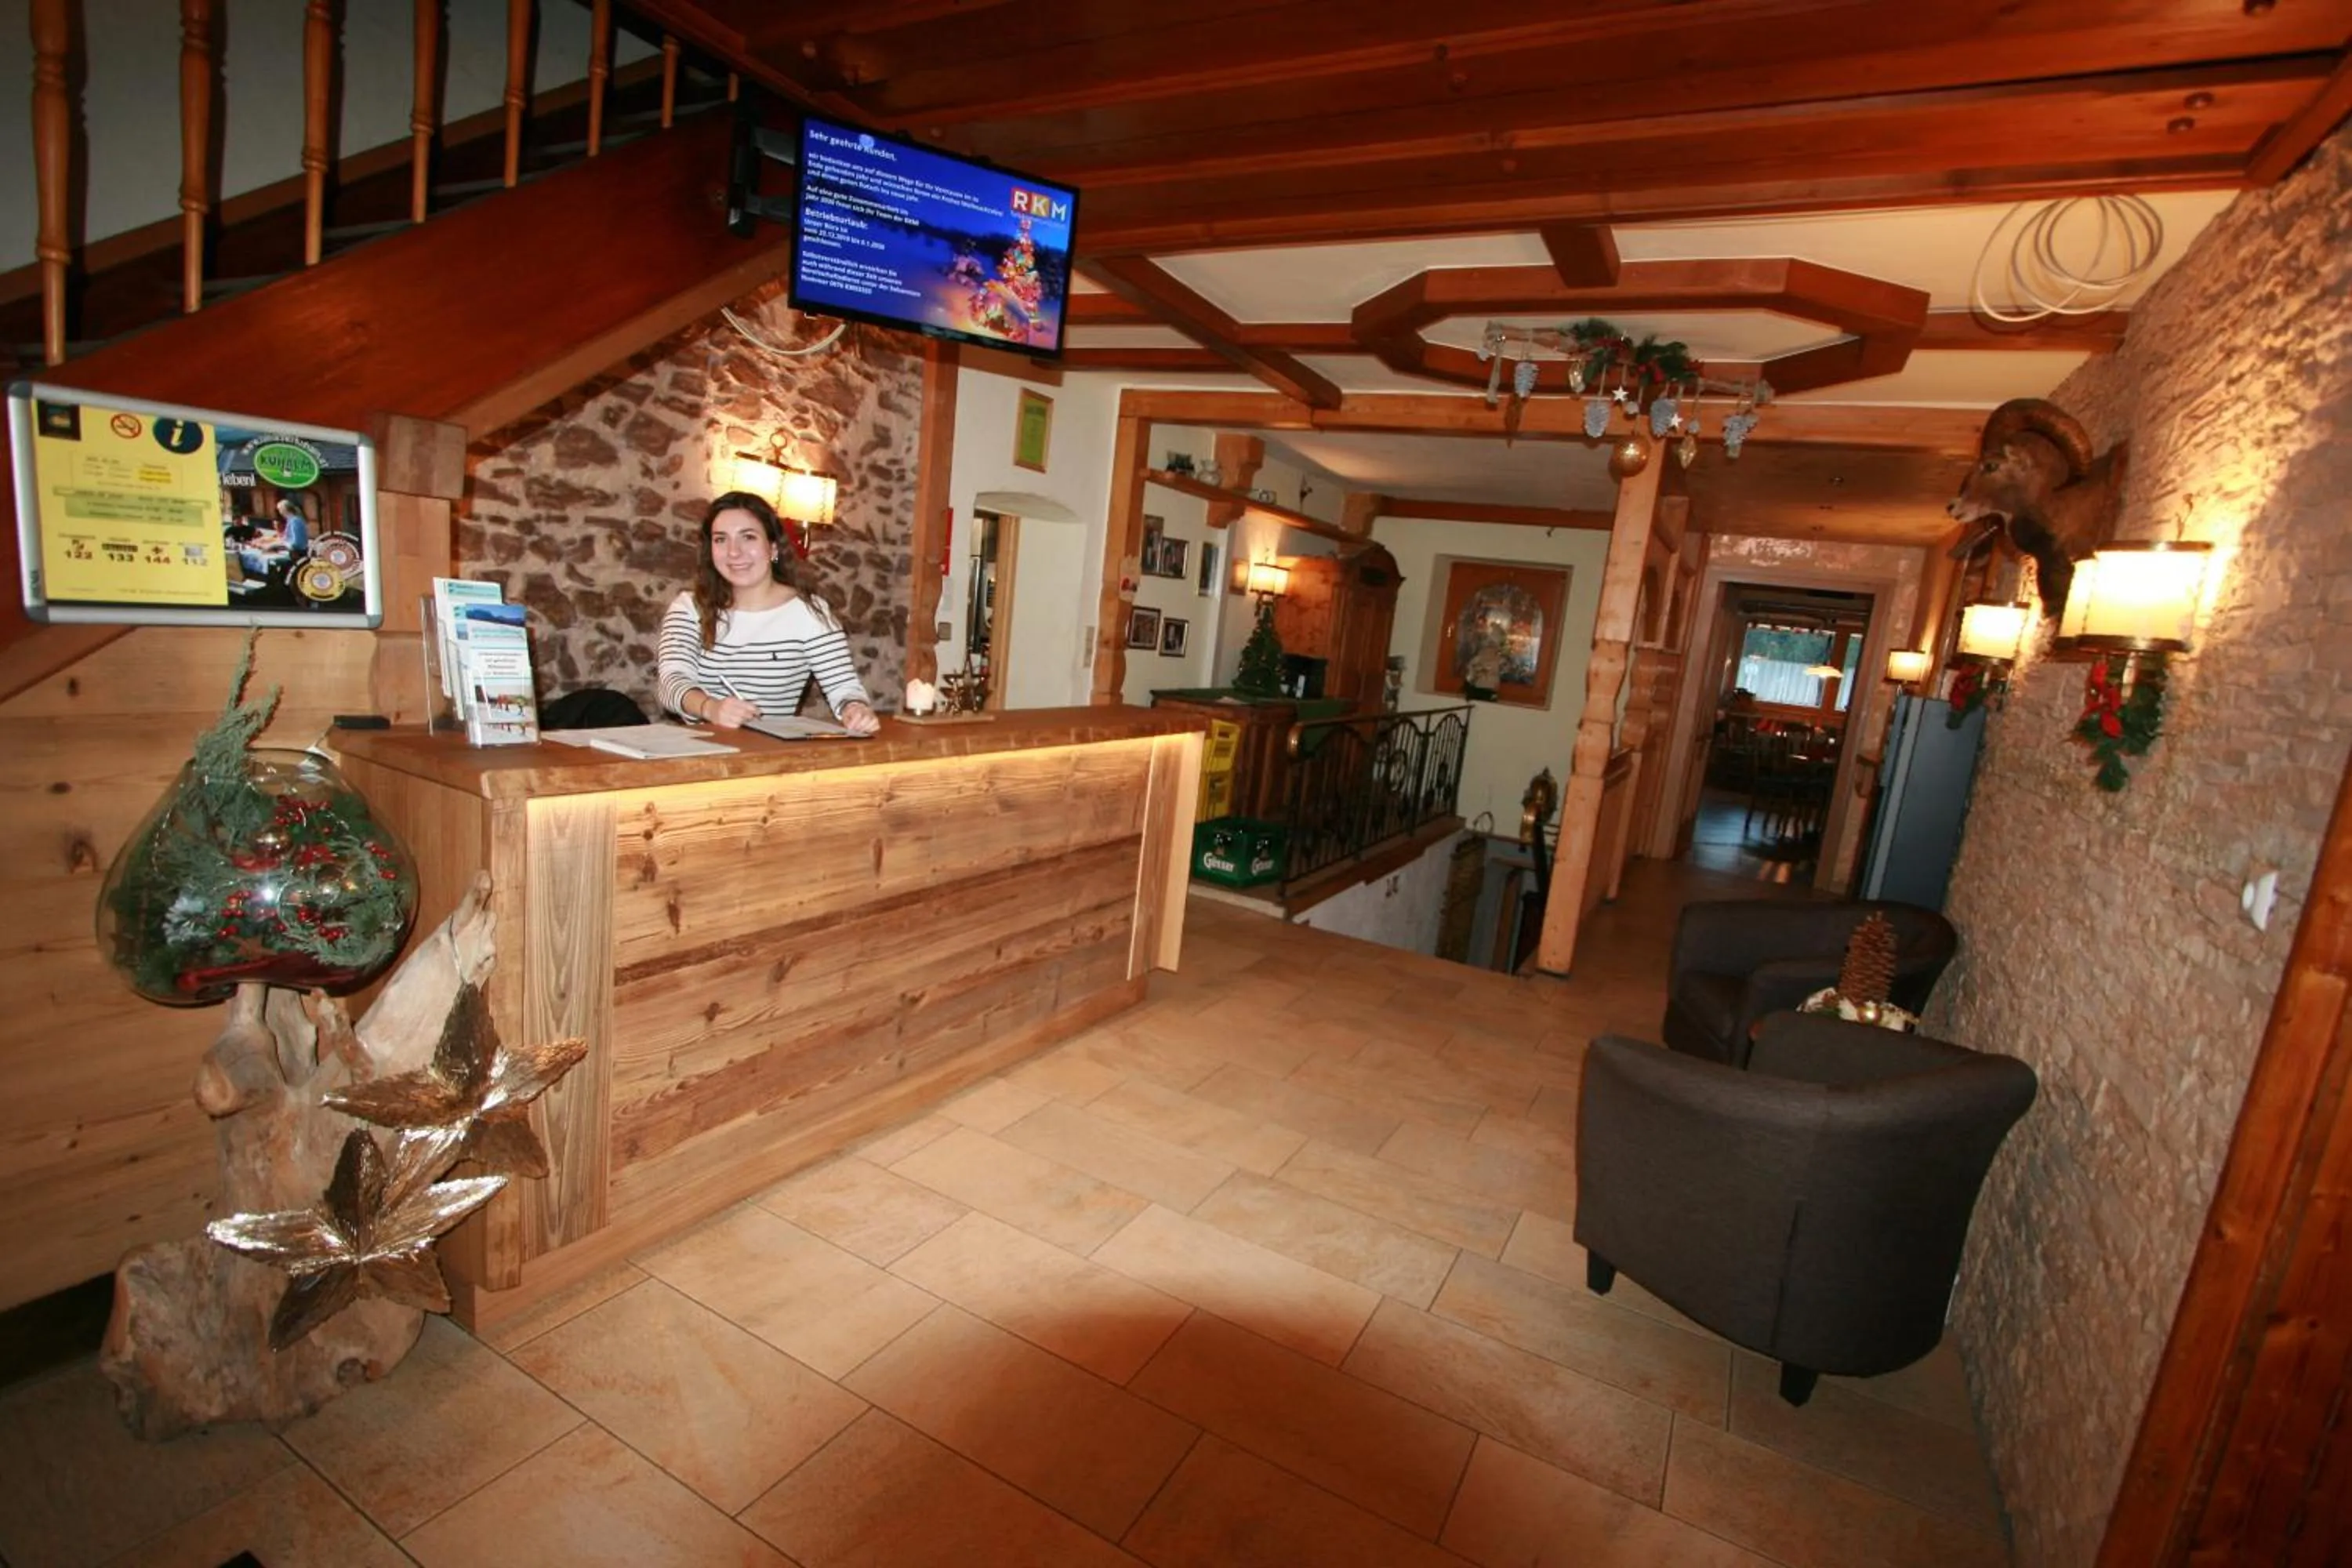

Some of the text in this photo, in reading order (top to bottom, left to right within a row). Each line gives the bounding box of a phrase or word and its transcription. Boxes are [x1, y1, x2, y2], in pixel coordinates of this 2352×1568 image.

[809, 129, 828, 141] Sehr
[829, 136, 862, 151] geehrte
[1013, 191, 1067, 221] RKM
[260, 453, 312, 470] KUHALM
[65, 550, 208, 566] 122 133 144 112
